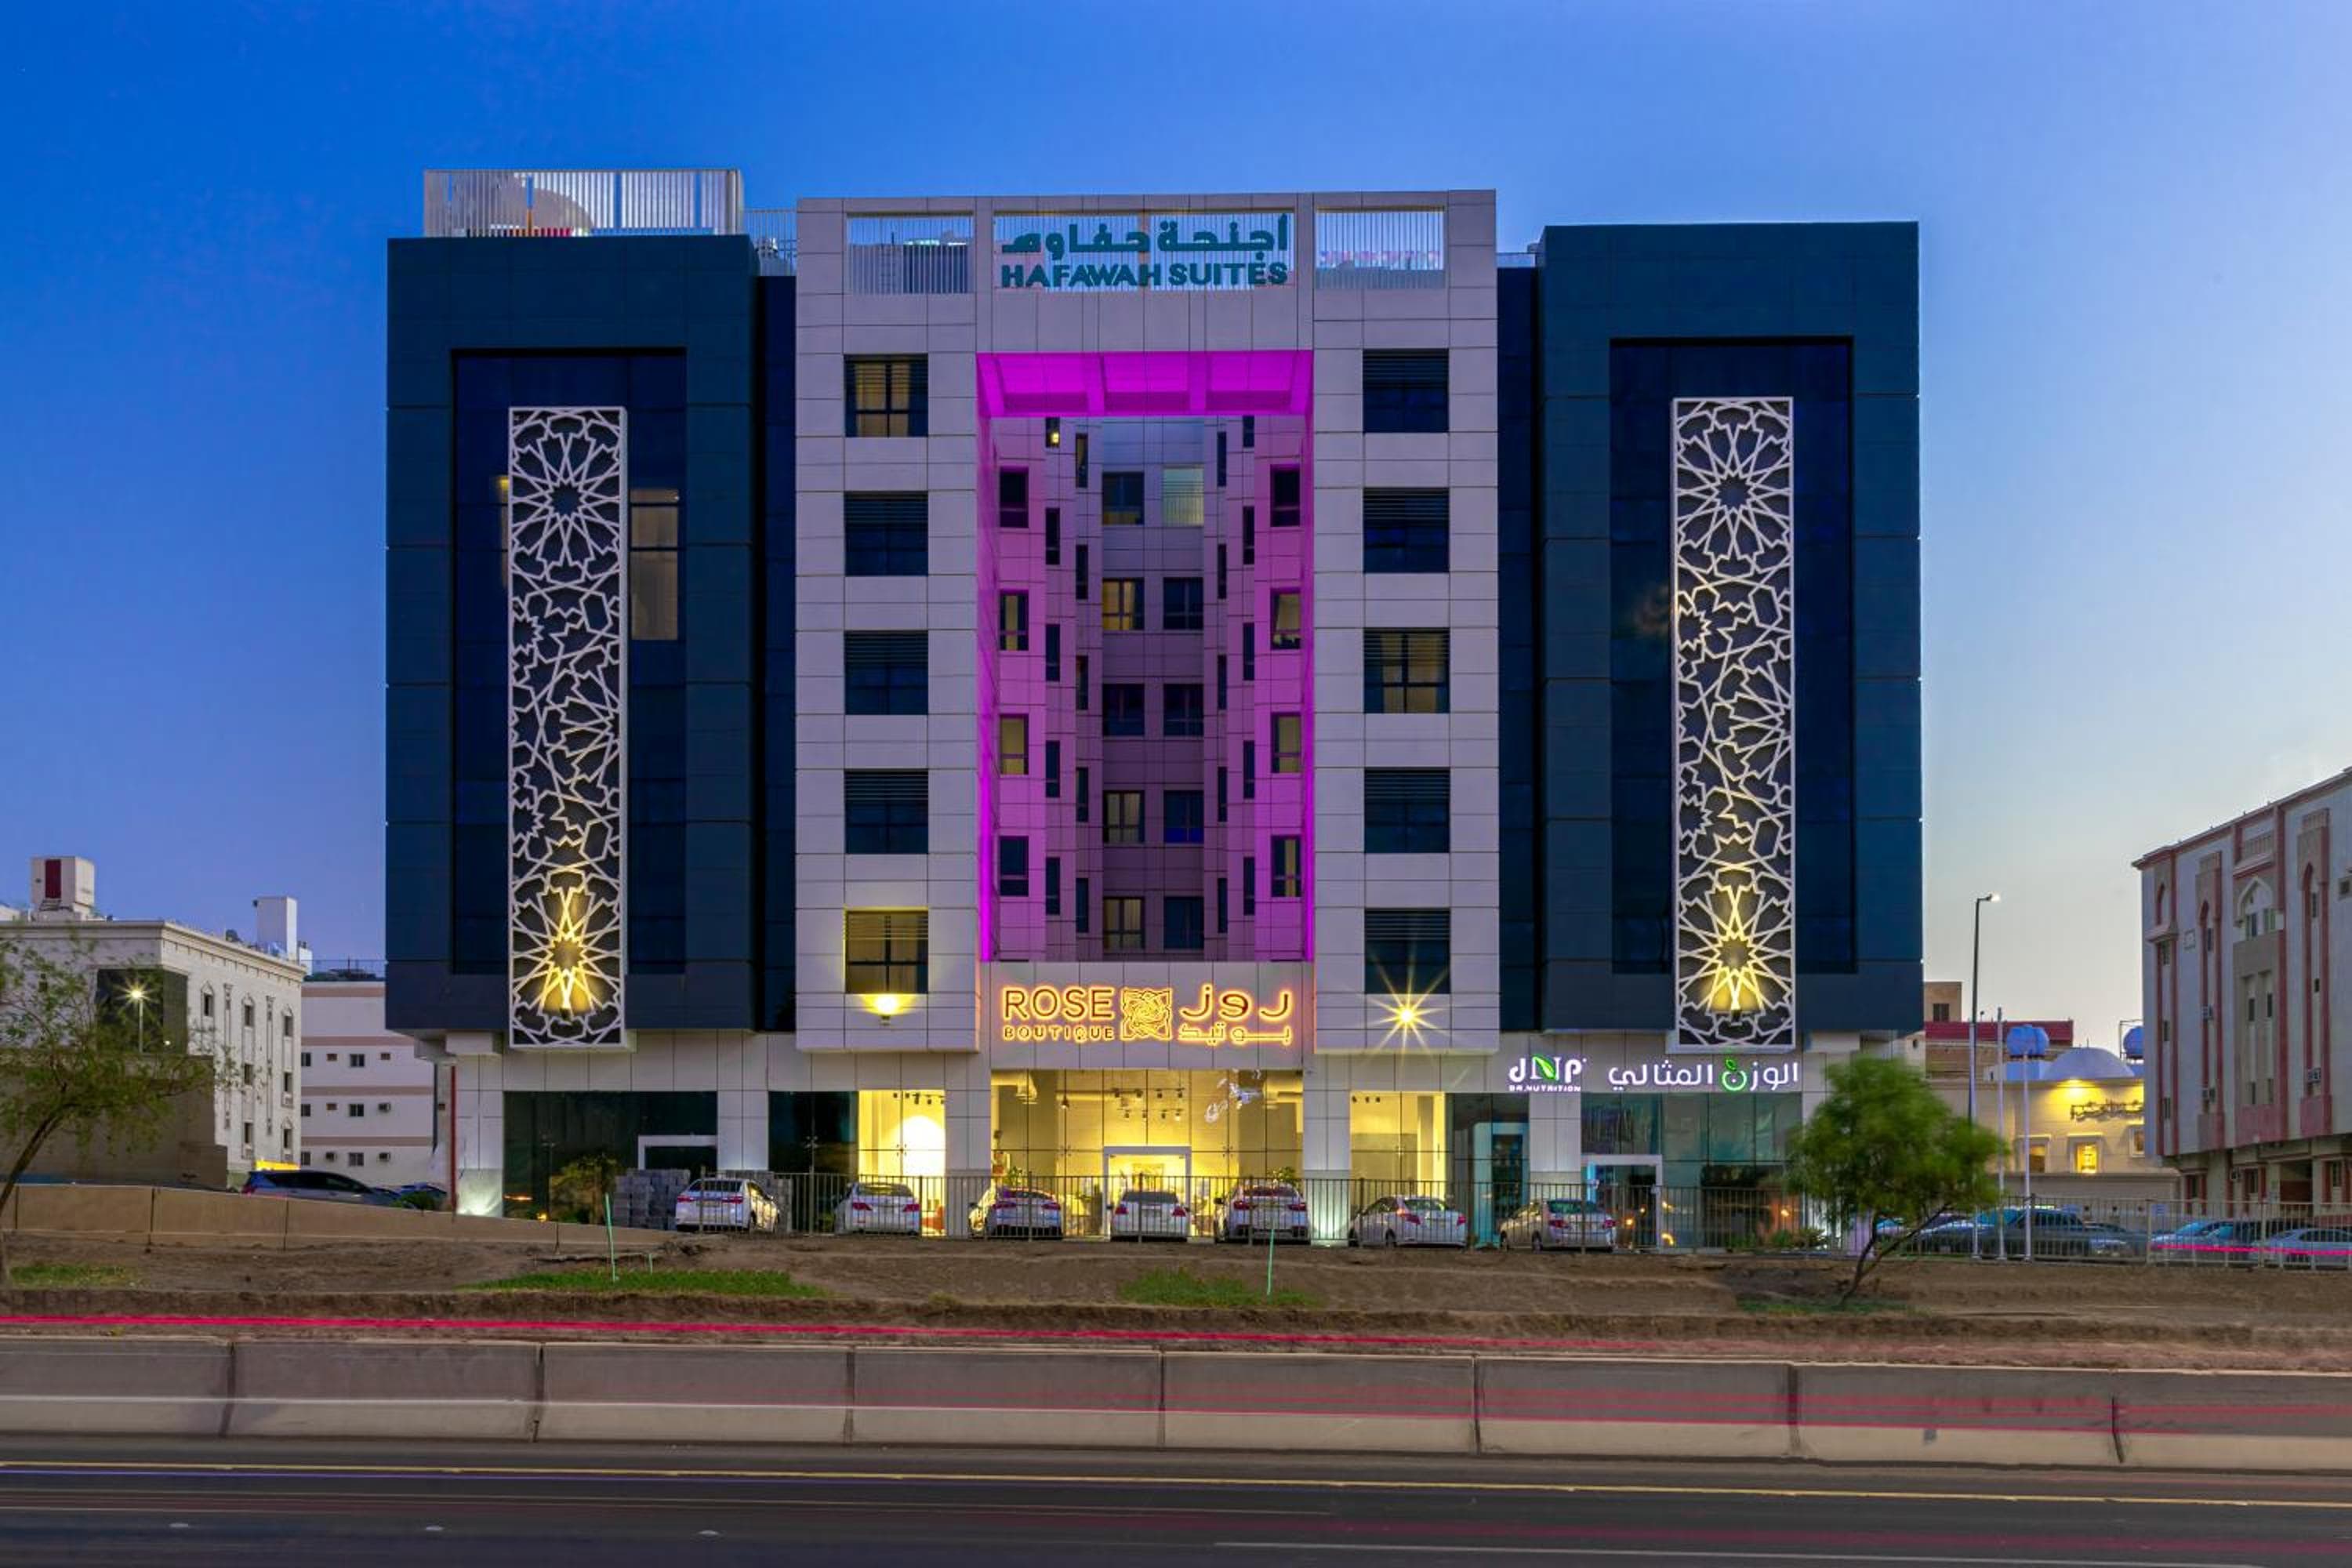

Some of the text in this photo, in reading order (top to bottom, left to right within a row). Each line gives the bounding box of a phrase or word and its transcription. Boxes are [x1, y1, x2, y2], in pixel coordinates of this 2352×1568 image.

[1001, 261, 1288, 288] HAFAWAH SUITES
[1004, 986, 1116, 1020] ROSE
[1179, 983, 1292, 1021] روز
[1003, 1025, 1114, 1043] BOUTIQUE
[1607, 1058, 1798, 1091] الوزن المثالي
